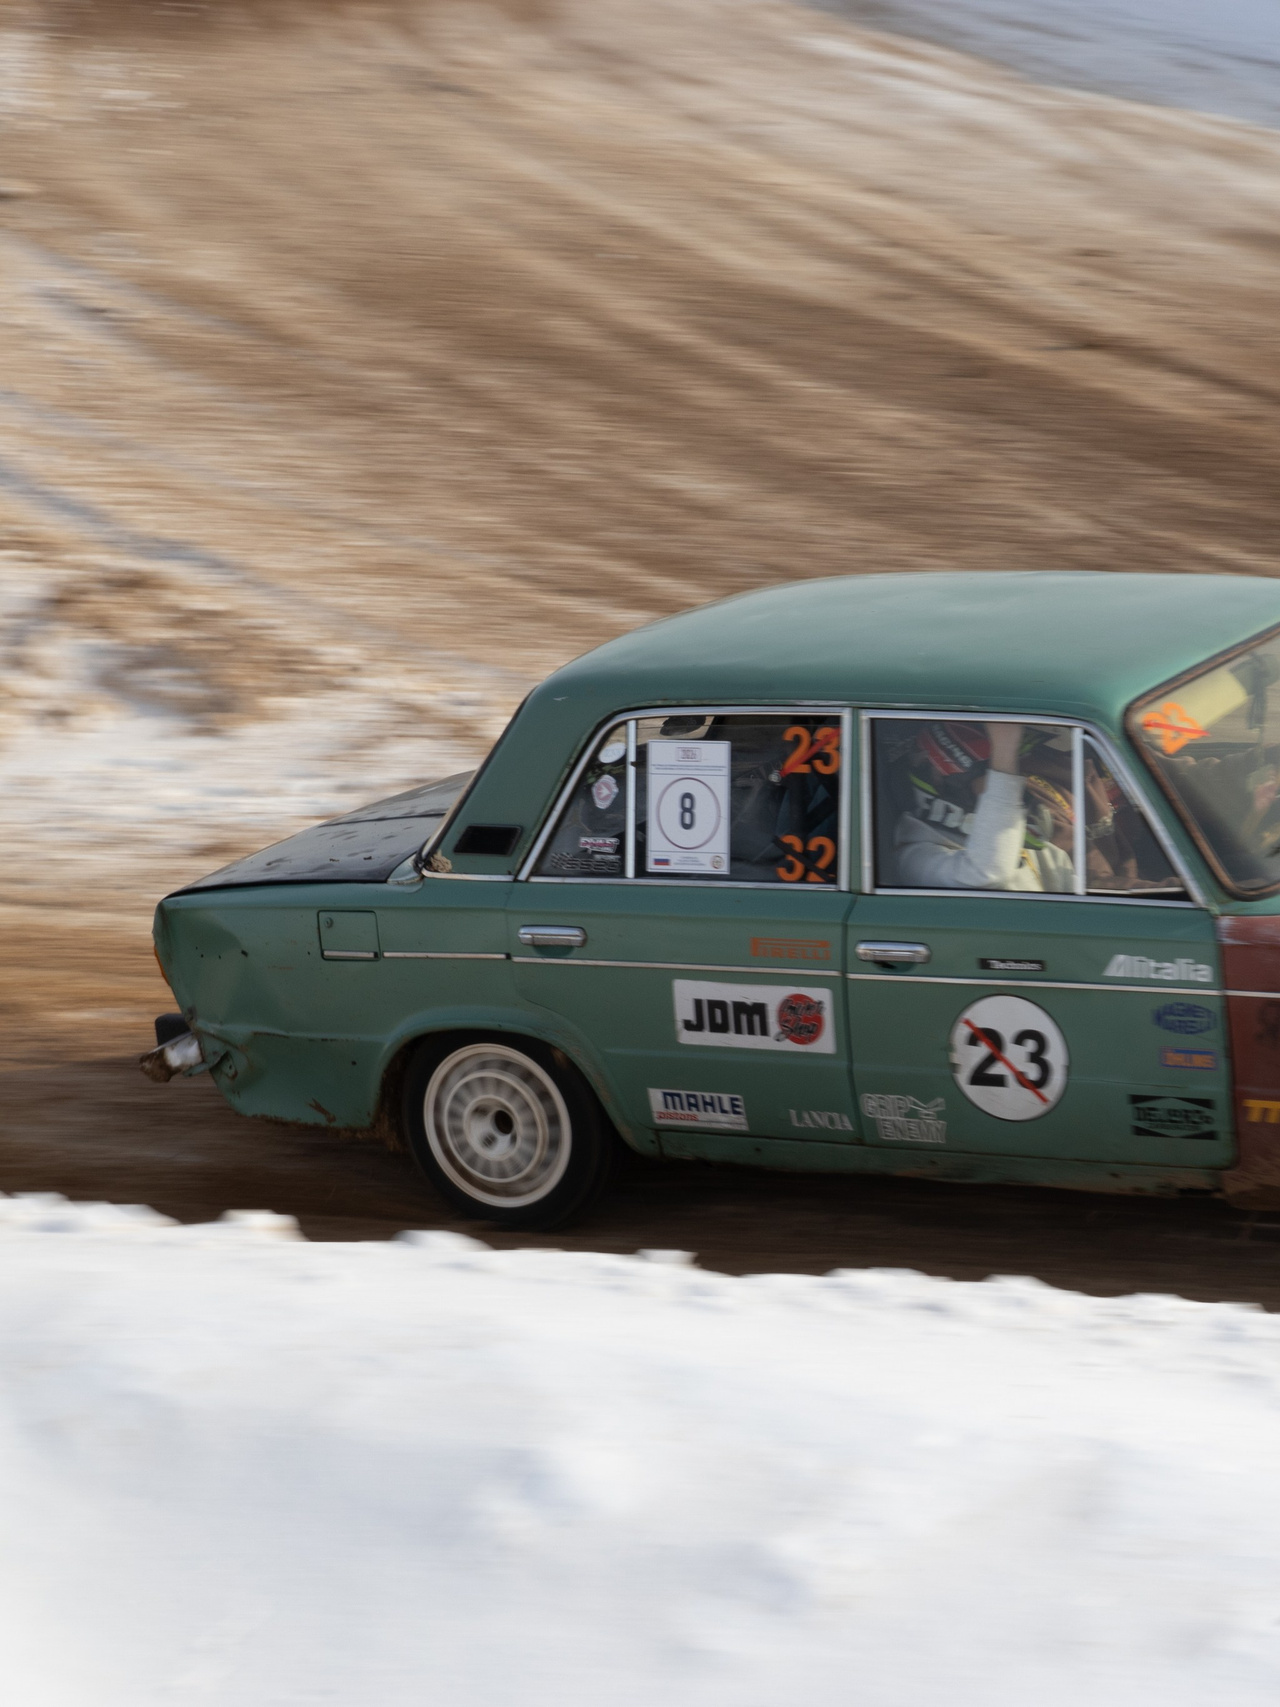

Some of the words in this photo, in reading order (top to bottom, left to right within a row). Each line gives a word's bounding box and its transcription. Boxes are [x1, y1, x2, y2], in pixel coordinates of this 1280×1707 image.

[783, 726, 841, 775] 23
[680, 792, 695, 830] 8
[776, 834, 836, 883] 32
[750, 936, 831, 961] PIRELLI
[1102, 954, 1214, 983] Alitalia
[683, 998, 770, 1037] JDM
[966, 1026, 1051, 1090] 23
[661, 1091, 744, 1116] MAHLE
[789, 1108, 854, 1131] LANCIA
